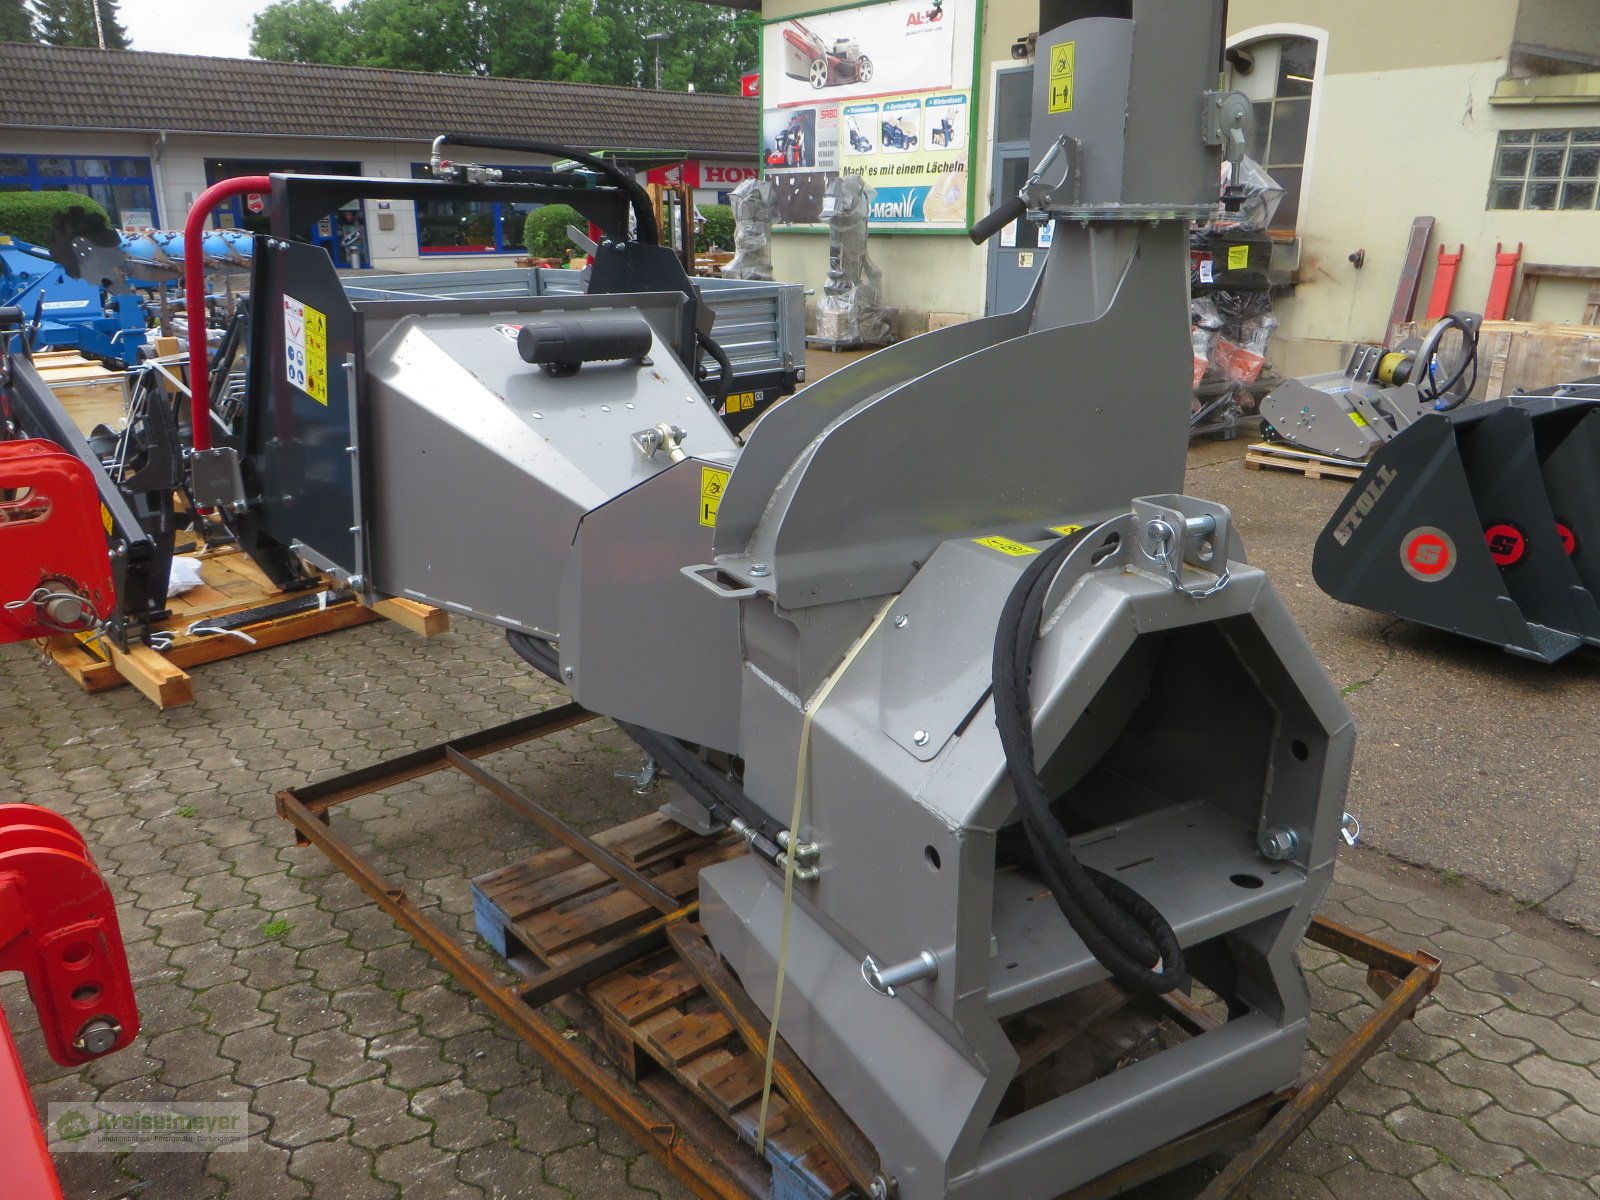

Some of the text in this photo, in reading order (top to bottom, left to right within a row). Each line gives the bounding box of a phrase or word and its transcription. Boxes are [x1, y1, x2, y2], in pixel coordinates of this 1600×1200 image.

[820, 109, 838, 119] SABO
[818, 160, 834, 168] SERVICE
[843, 160, 965, 178] Mach' es mit einem Lächeln
[1332, 464, 1398, 547] STOLL
